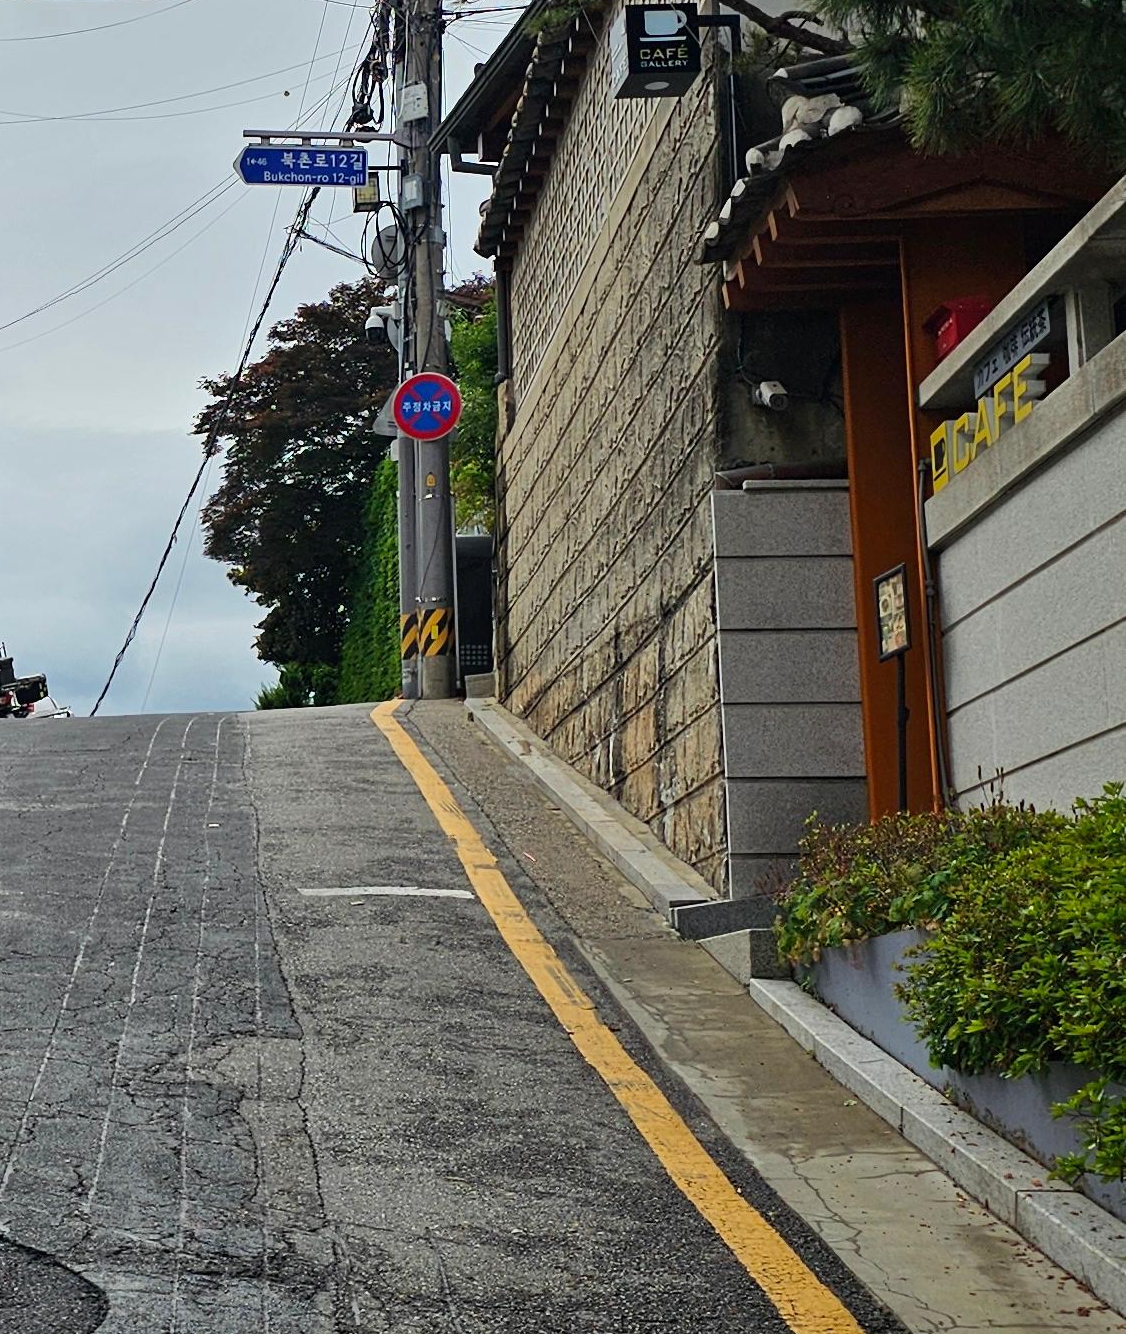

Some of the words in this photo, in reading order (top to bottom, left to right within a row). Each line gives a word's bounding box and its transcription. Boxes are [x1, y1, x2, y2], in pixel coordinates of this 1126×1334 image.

[639, 43, 689, 60] CAFÉ
[640, 59, 689, 68] GALLERY
[280, 151, 364, 171] 북촌로12길
[263, 170, 329, 183] Bukchon-ro
[332, 172, 364, 185] 12-gil
[402, 399, 452, 413] 주정차금지
[952, 353, 1034, 476] CAFE
